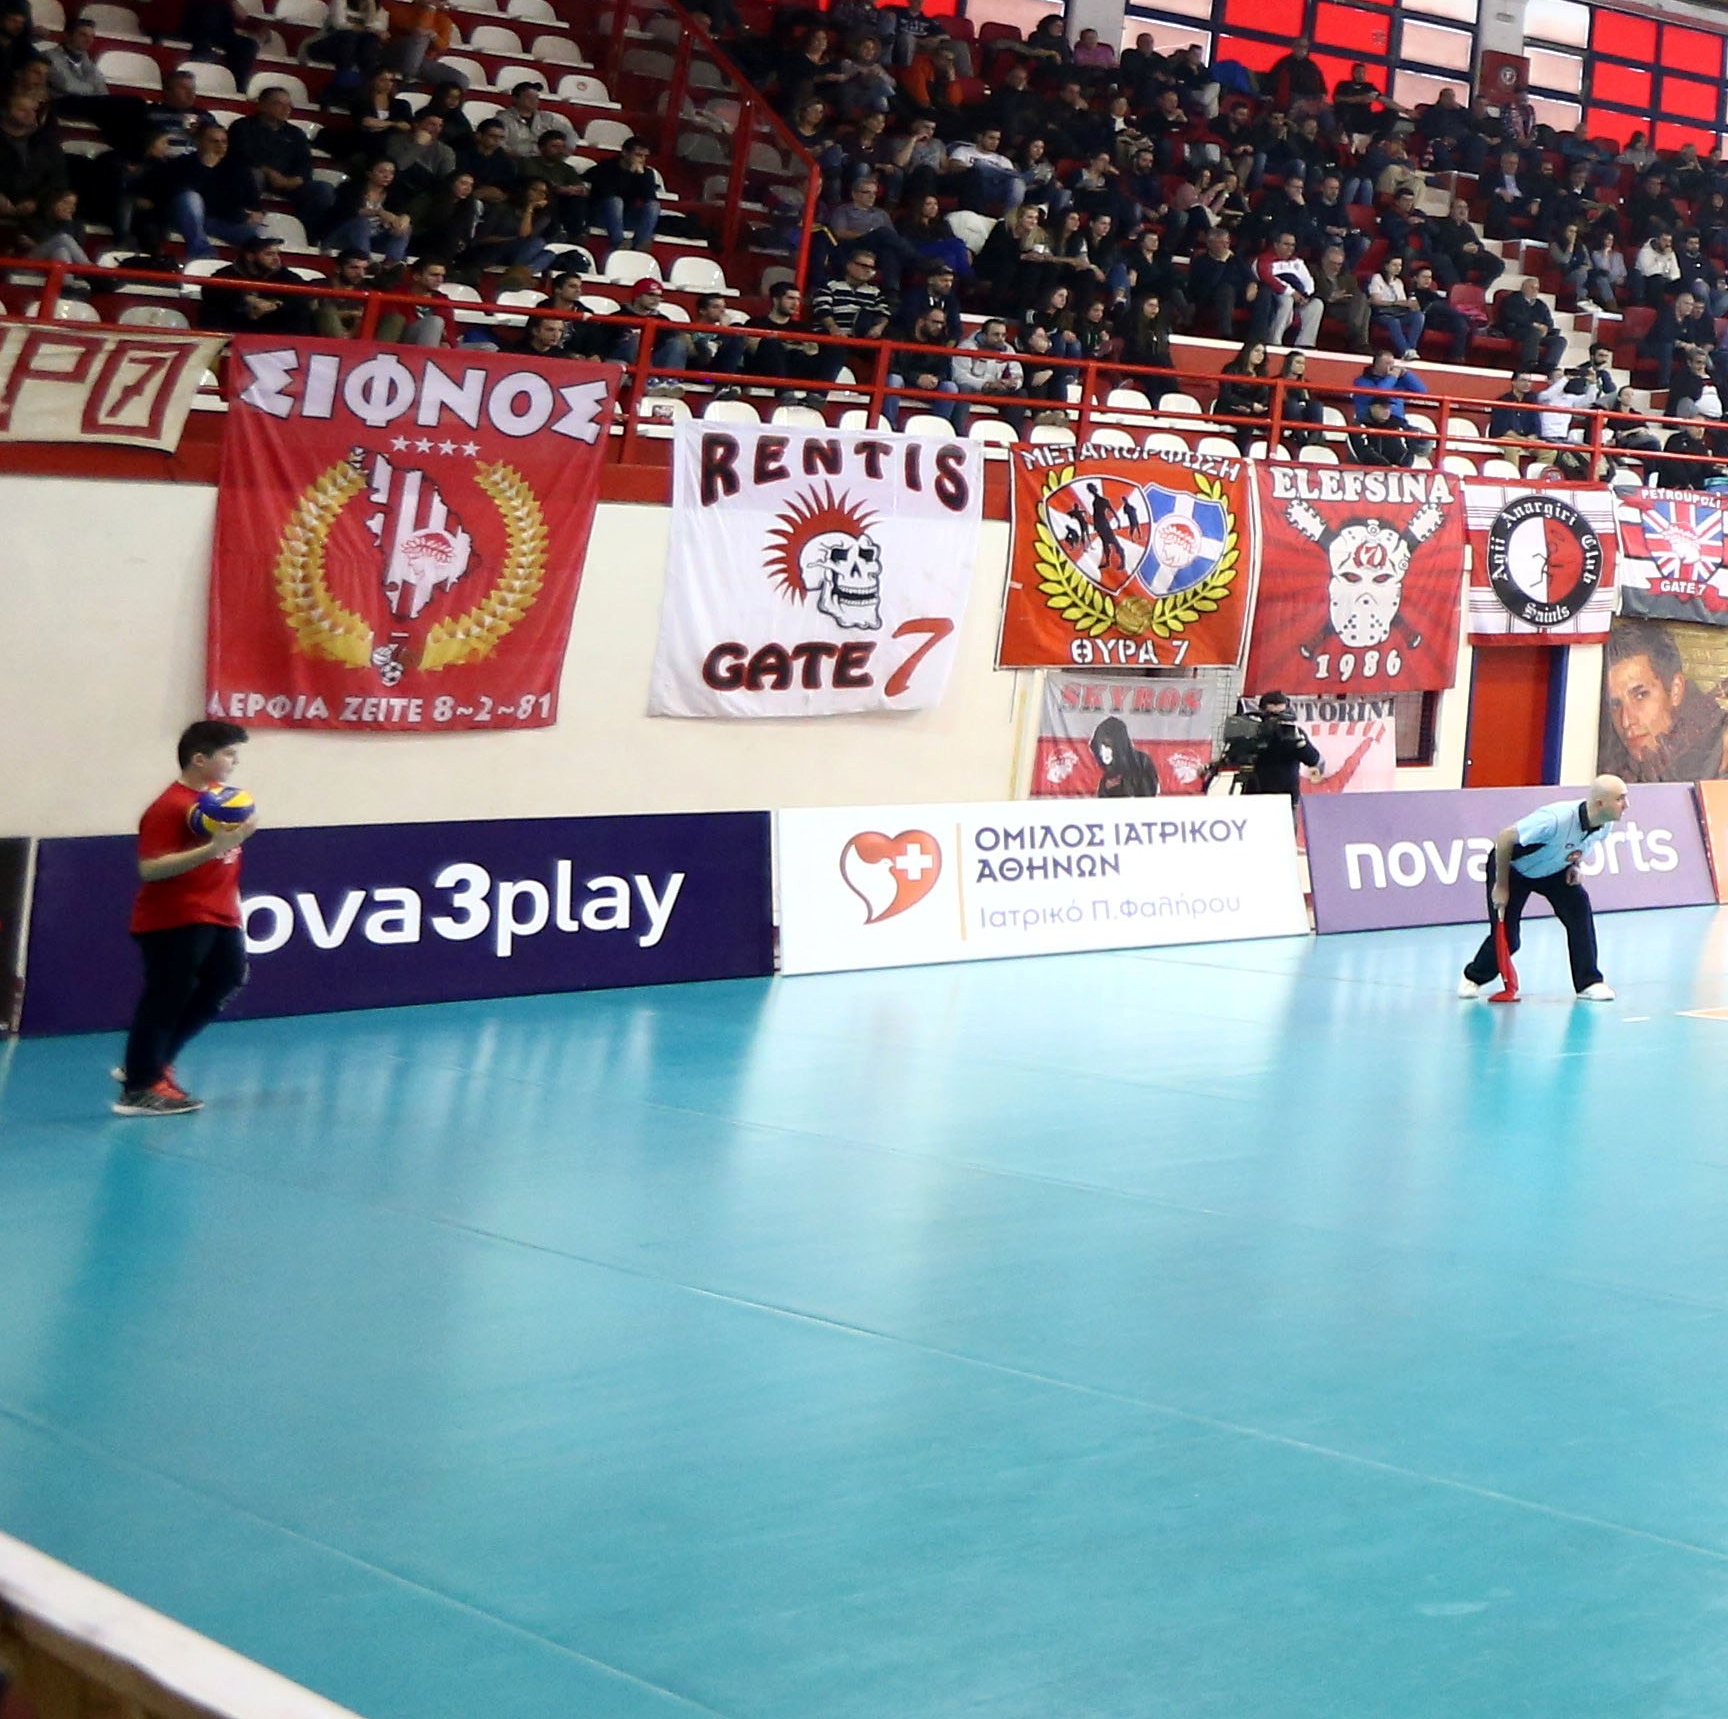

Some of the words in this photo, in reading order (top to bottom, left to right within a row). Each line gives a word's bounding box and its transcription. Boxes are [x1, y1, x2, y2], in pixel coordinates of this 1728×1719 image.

[239, 349, 610, 446] ΣΙΦΝΟΣ
[702, 432, 969, 512] RENTIS
[1269, 465, 1455, 505] ELEFSINA
[1641, 488, 1721, 509] PETROUPOLI
[1501, 501, 1578, 529] Anargiri
[1581, 534, 1599, 585] Club
[1660, 580, 1695, 595] GATE
[1698, 584, 1706, 596] 7
[702, 640, 878, 692] GATE
[884, 617, 954, 698] 7
[1070, 638, 1159, 665] ΘΥΡΑ
[1171, 639, 1190, 667] 7
[1315, 649, 1402, 681] 1986
[338, 695, 424, 723] ΖΕΙΤΕ
[1060, 684, 1203, 717] SKYROS
[974, 824, 1106, 852] ΟΜΙΛΟΣ
[1115, 818, 1248, 846] ΙΑΤΡΙΚΟΥ
[975, 853, 1121, 883] ΑΘΗΝΩΝ
[1344, 828, 1679, 889] novaorts
[241, 859, 687, 958] ova3play
[979, 900, 1084, 931] Ιατρικό
